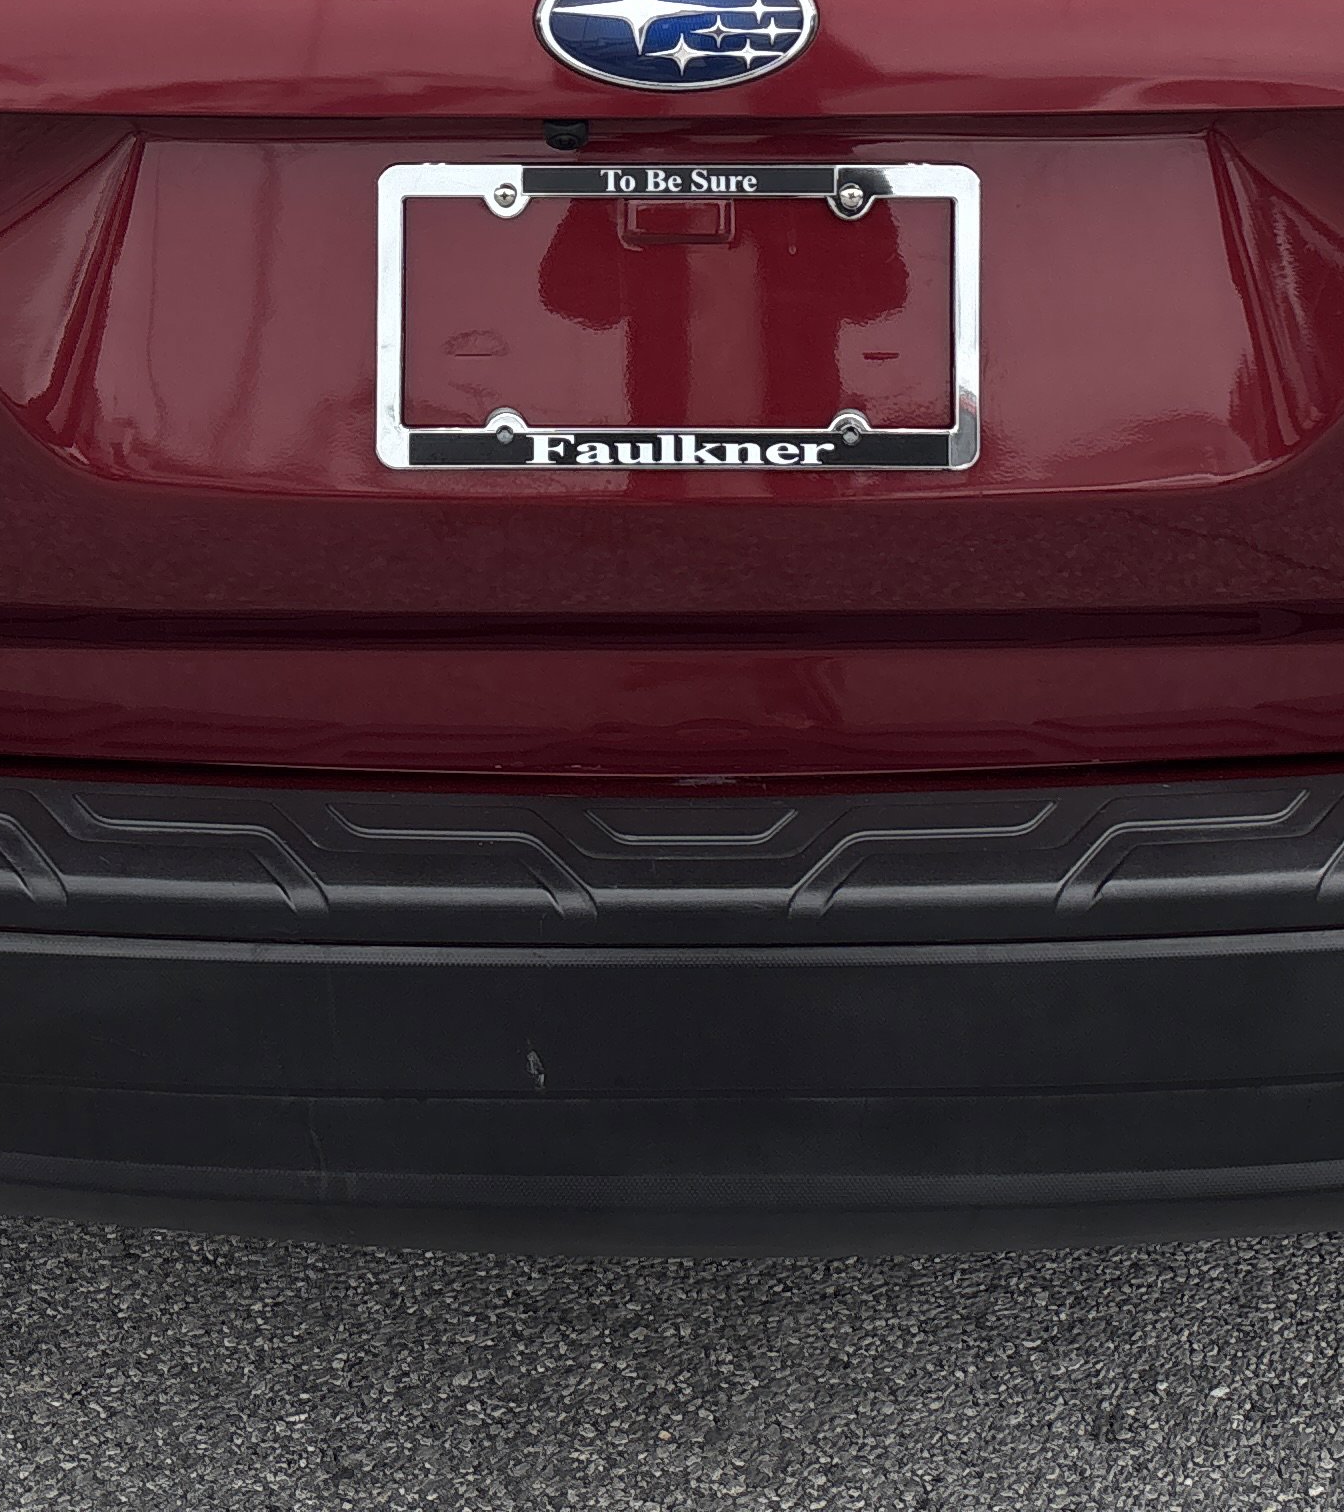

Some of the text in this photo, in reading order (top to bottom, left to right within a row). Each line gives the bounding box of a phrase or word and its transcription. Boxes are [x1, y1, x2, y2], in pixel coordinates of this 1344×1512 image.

[600, 168, 758, 192] To Be Sure
[526, 434, 835, 466] Faulkner
